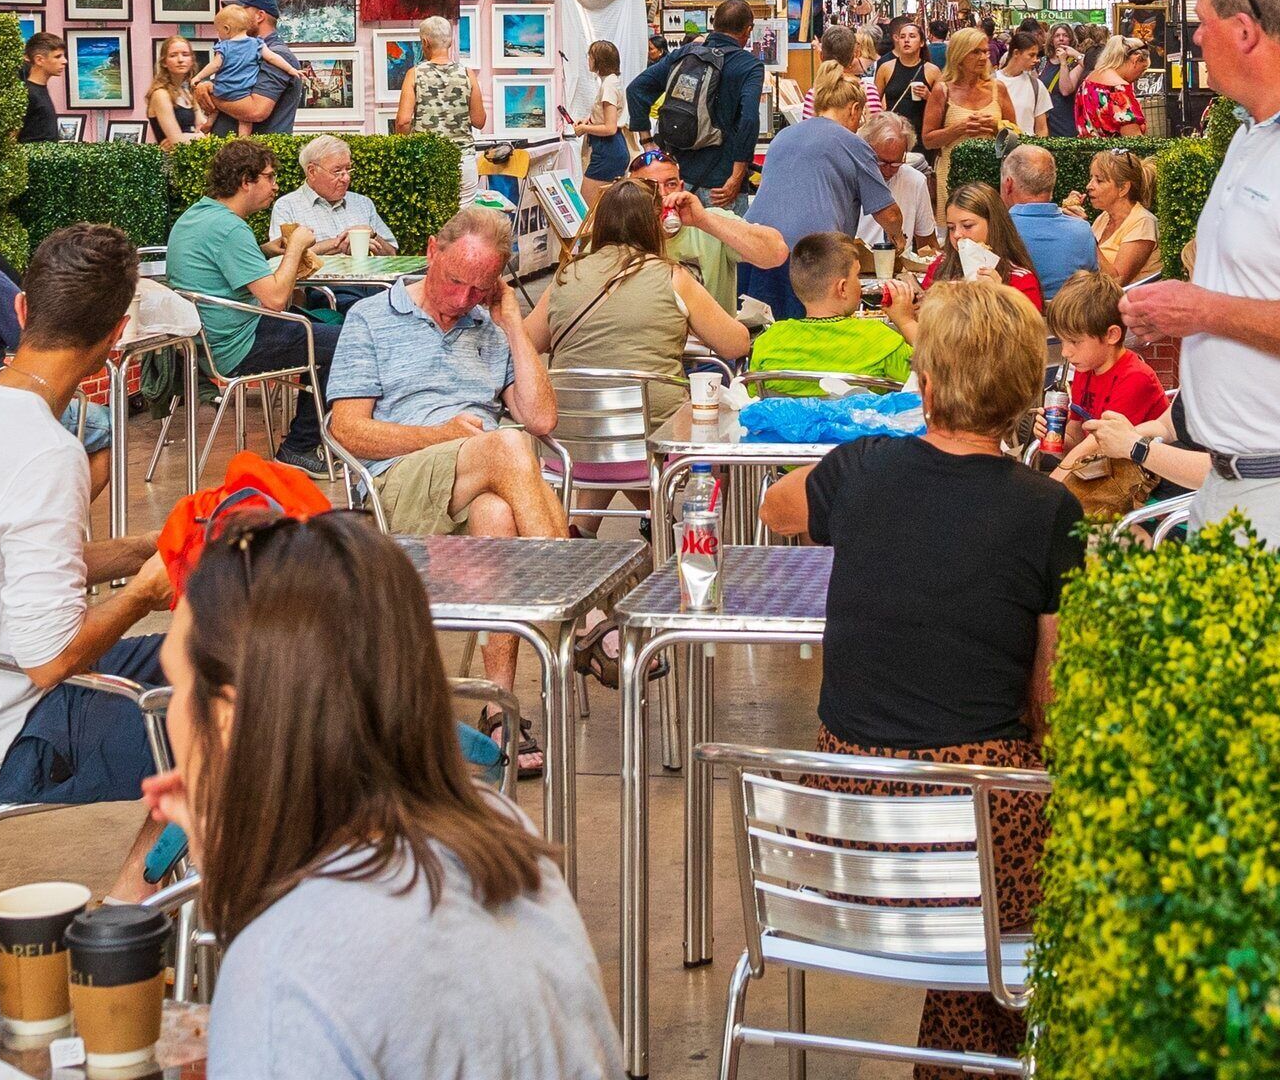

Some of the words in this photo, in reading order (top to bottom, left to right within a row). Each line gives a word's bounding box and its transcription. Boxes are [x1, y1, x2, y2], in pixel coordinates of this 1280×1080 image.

[1018, 12, 1039, 20] TOM
[1049, 11, 1073, 19] OLLIE
[682, 530, 718, 555] oke
